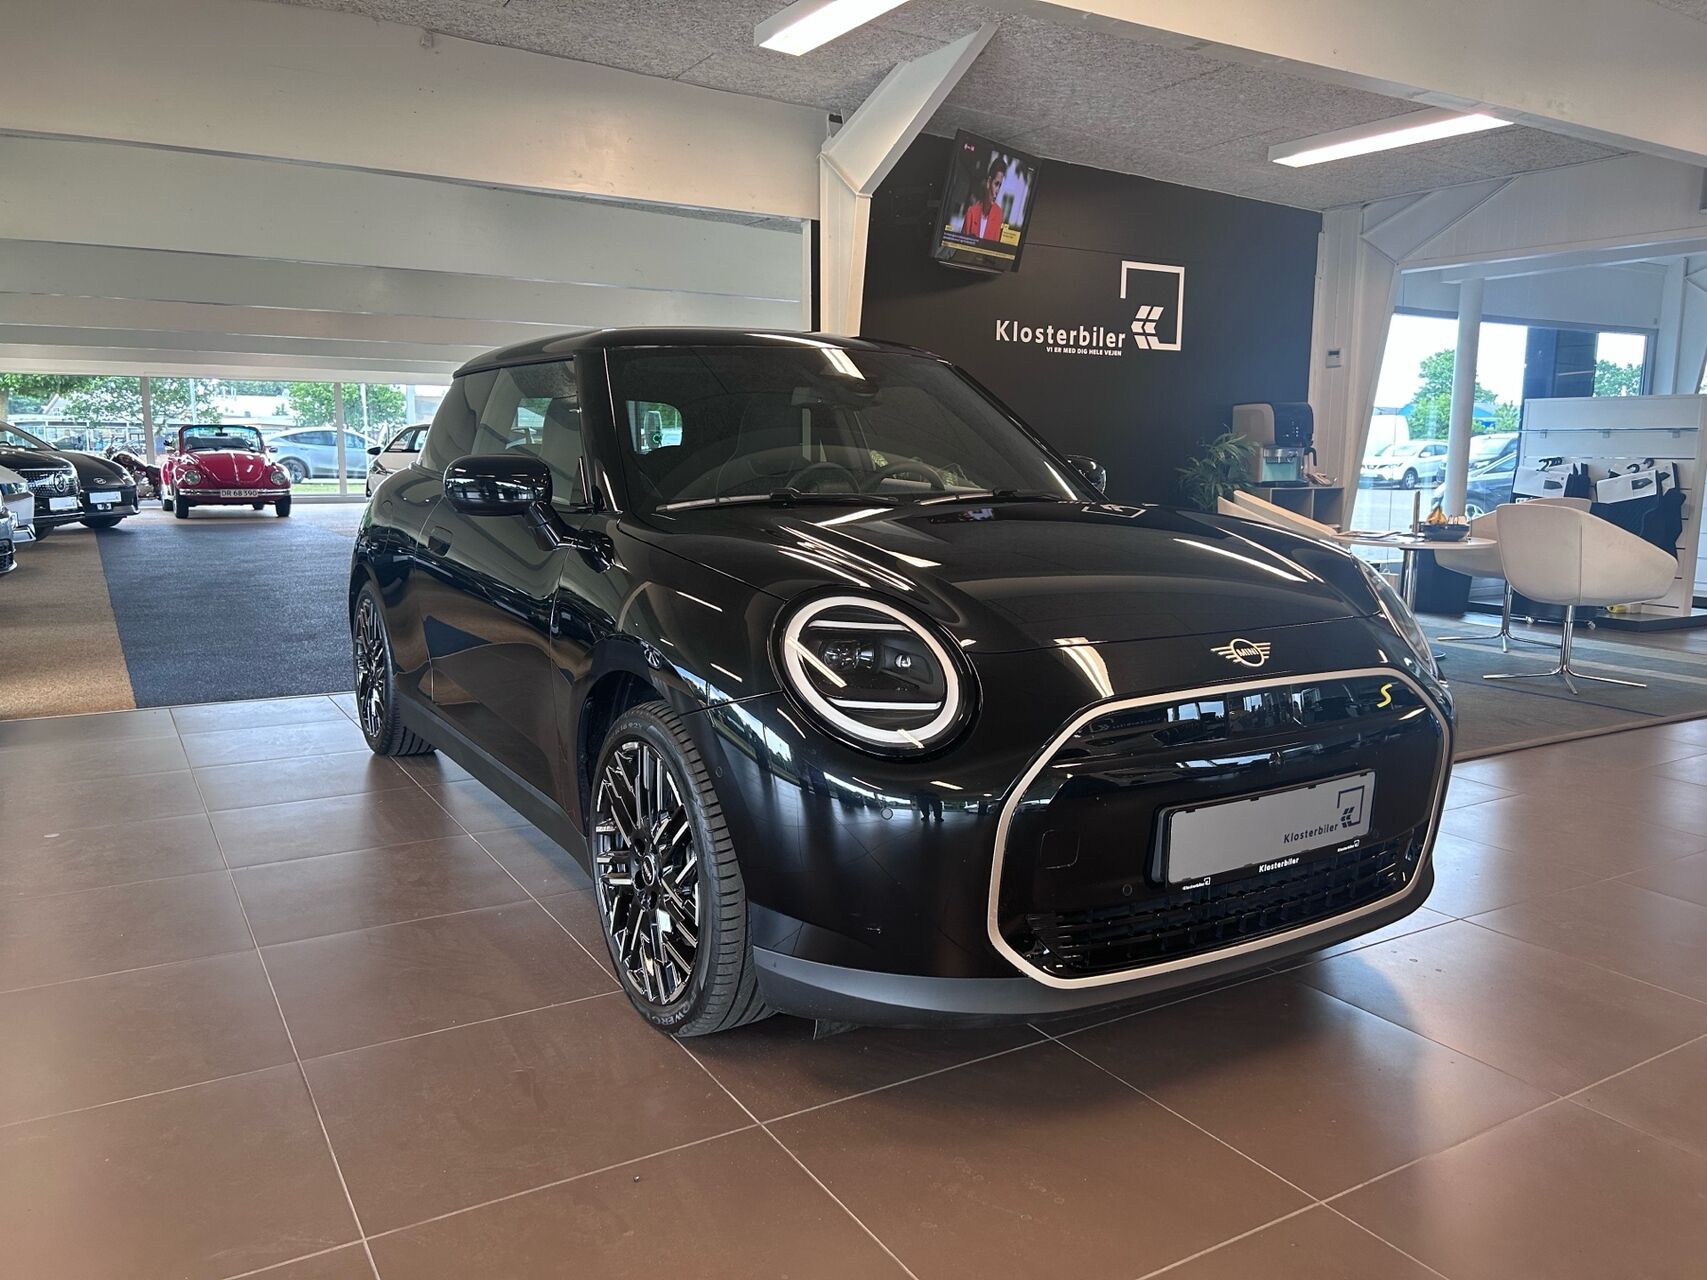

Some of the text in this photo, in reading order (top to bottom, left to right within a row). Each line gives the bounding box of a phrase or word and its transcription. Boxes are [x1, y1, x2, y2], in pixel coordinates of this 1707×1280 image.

[995, 319, 1126, 348] Klosterbiler
[1377, 683, 1392, 709] S
[1283, 822, 1339, 844] Klosterbiler
[1258, 856, 1300, 873] Klosterbiler
